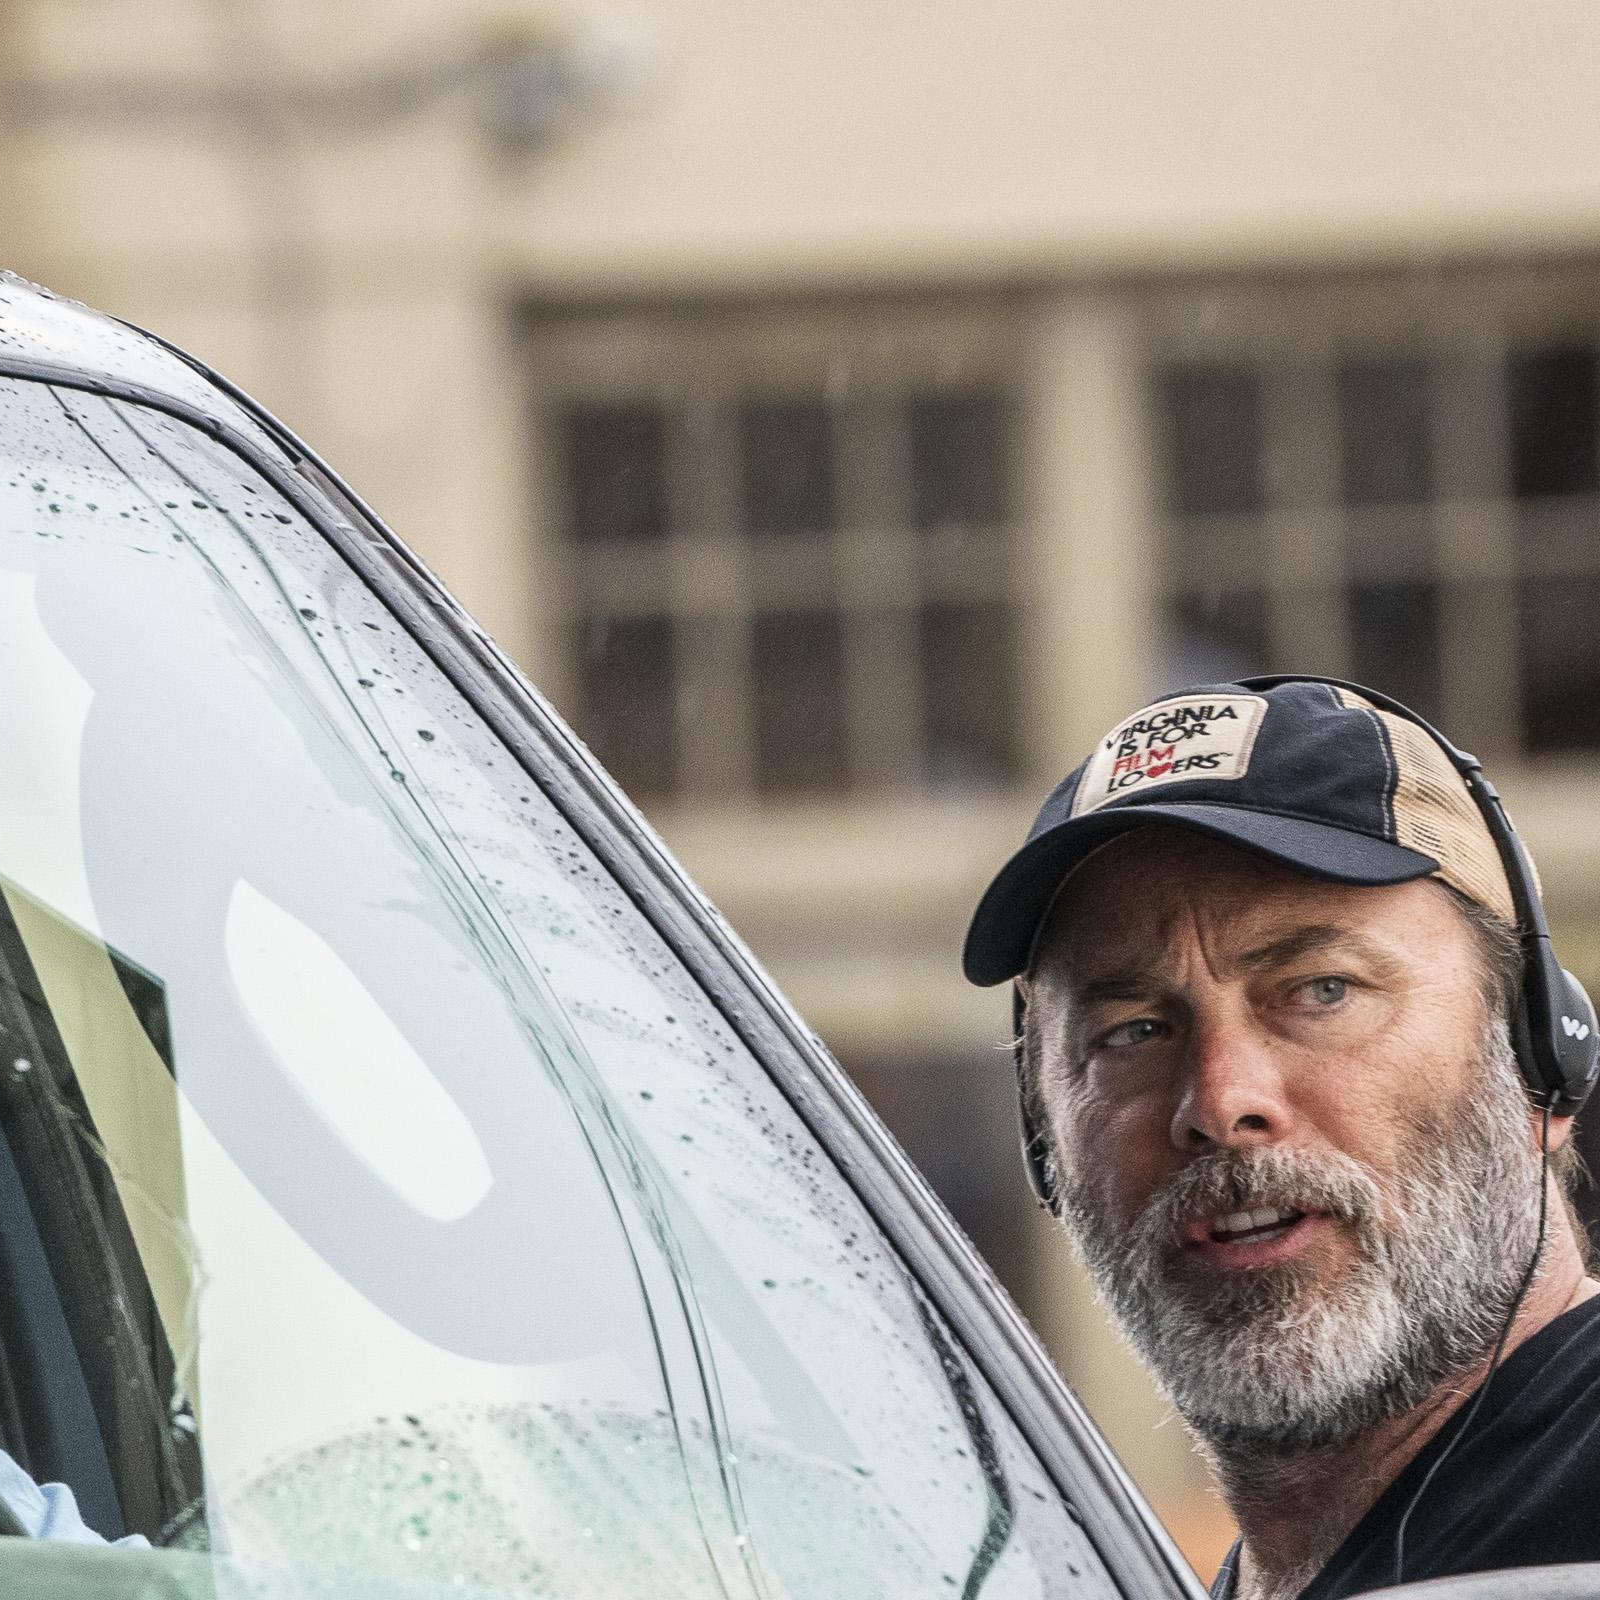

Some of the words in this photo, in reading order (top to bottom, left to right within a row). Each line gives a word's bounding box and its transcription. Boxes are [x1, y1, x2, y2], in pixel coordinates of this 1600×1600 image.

[1117, 739, 1138, 759] IS
[1146, 723, 1211, 748] FOR
[1112, 745, 1176, 777] FILM
